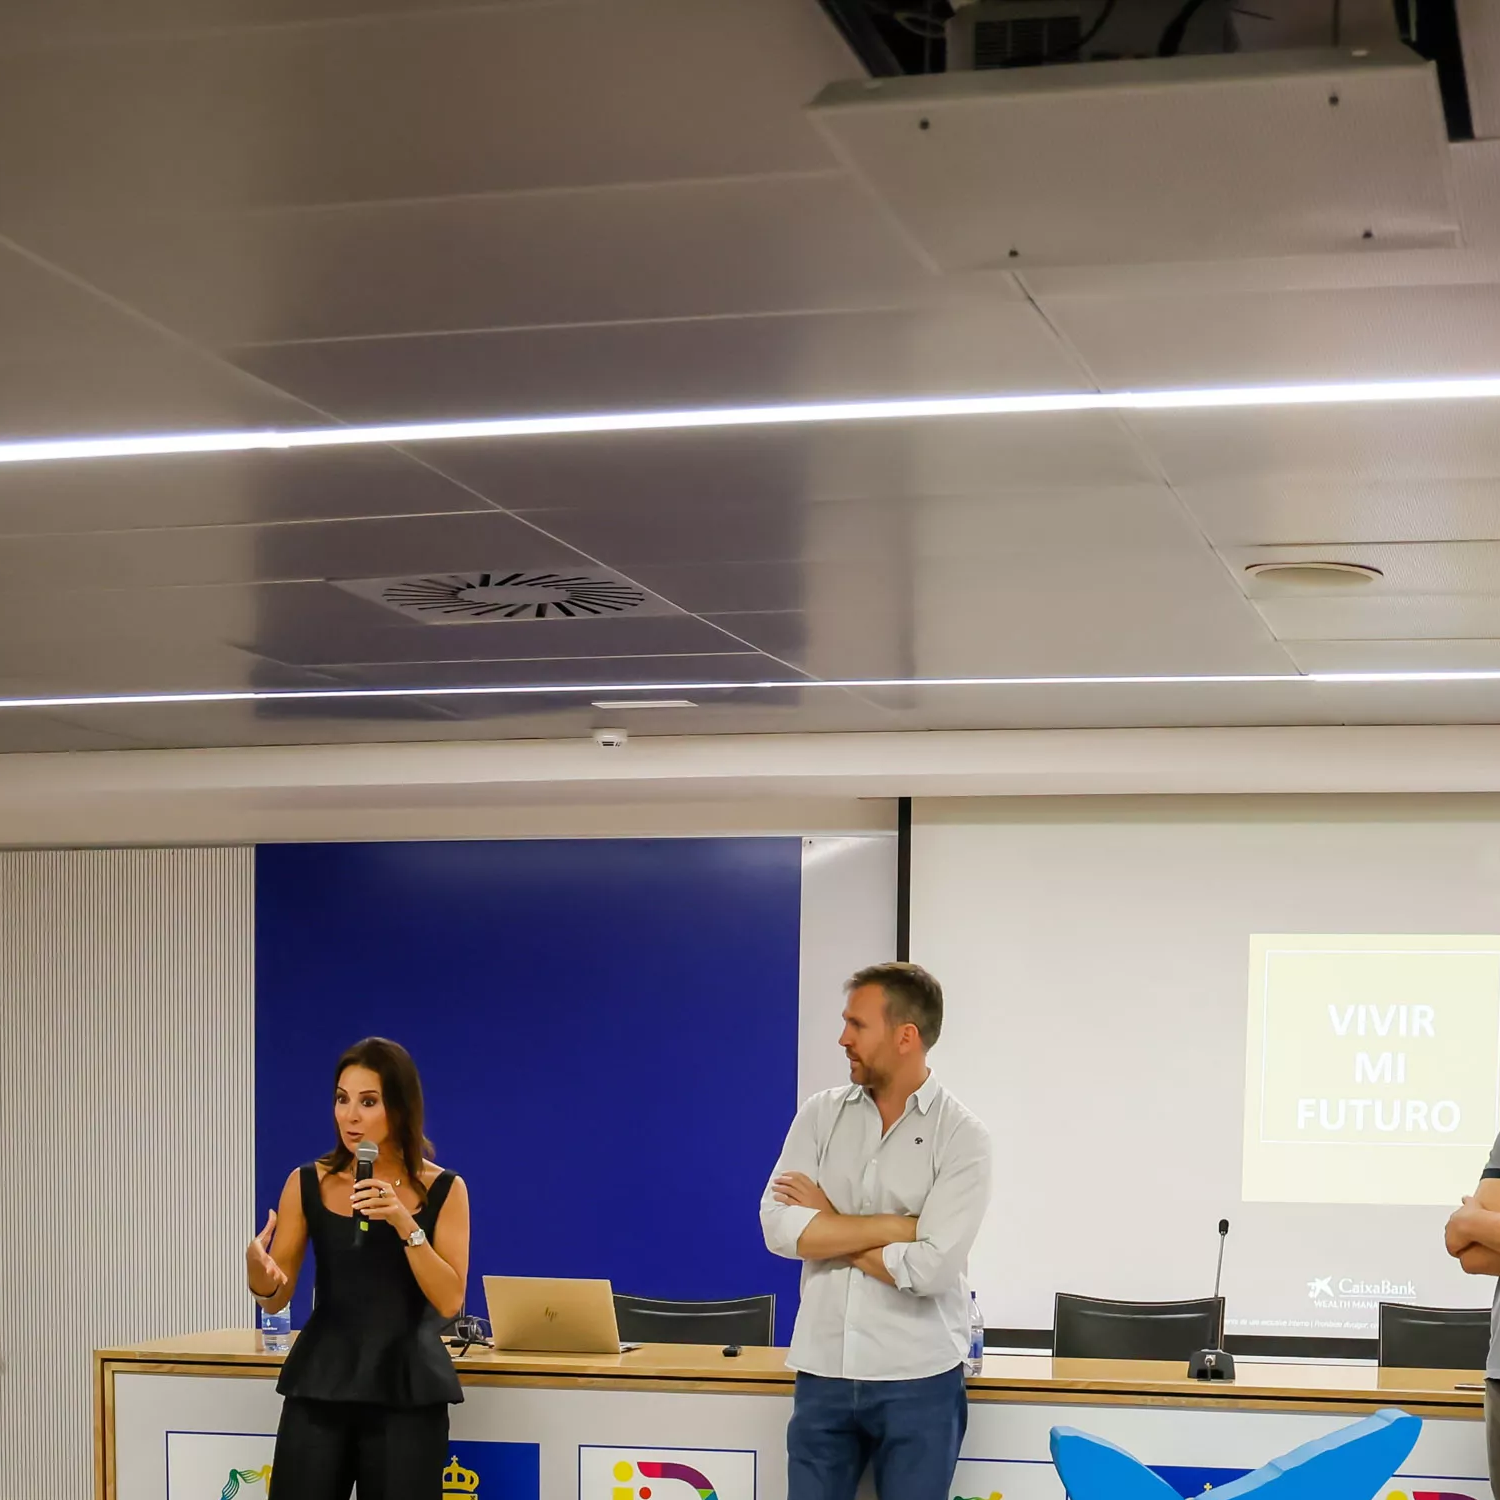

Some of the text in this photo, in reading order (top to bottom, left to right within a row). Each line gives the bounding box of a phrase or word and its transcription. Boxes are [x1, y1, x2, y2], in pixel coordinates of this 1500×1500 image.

[1327, 1004, 1435, 1037] VIVIR
[1355, 1052, 1406, 1084] MI
[1297, 1098, 1461, 1133] FUTURO
[1338, 1278, 1416, 1295] CaixaBank
